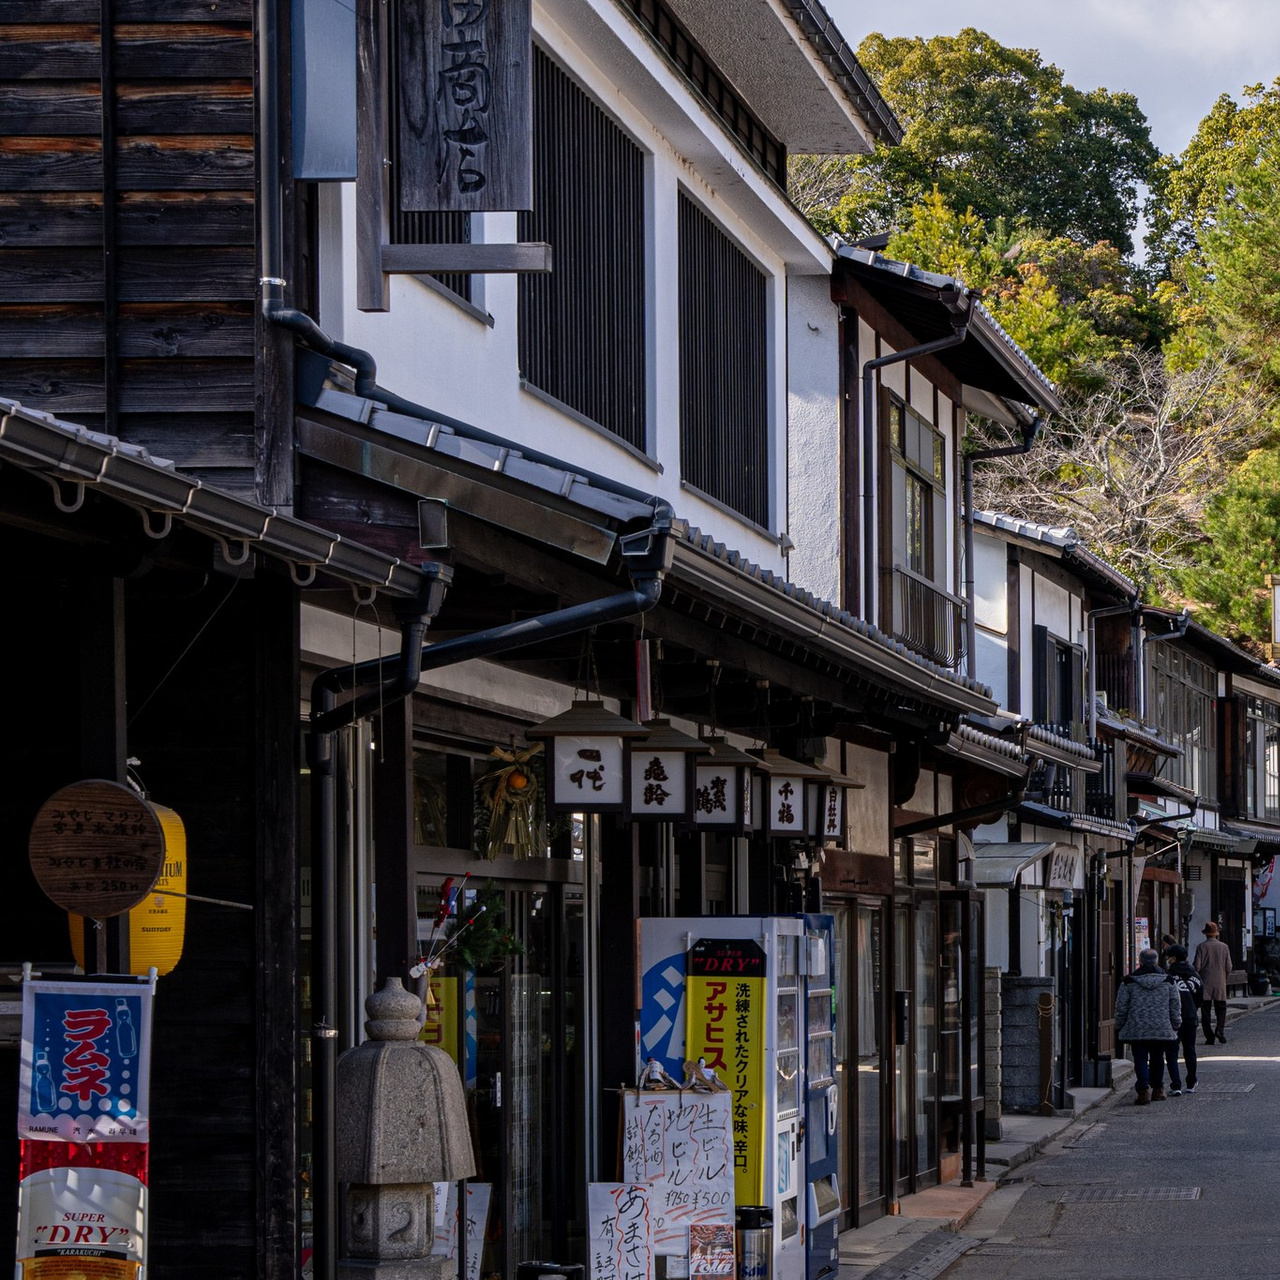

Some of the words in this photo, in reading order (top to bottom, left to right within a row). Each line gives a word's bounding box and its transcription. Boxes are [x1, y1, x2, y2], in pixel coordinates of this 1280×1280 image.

[570, 748, 605, 792] 一代
[778, 780, 794, 824] 千福
[60, 1008, 112, 1102] ラムネ
[734, 983, 751, 1173] 洗練されたクリアな味、辛口。
[29, 1126, 58, 1134] RAMUNE
[693, 1103, 726, 1181] 生ビール
[63, 1213, 105, 1222] SUPER
